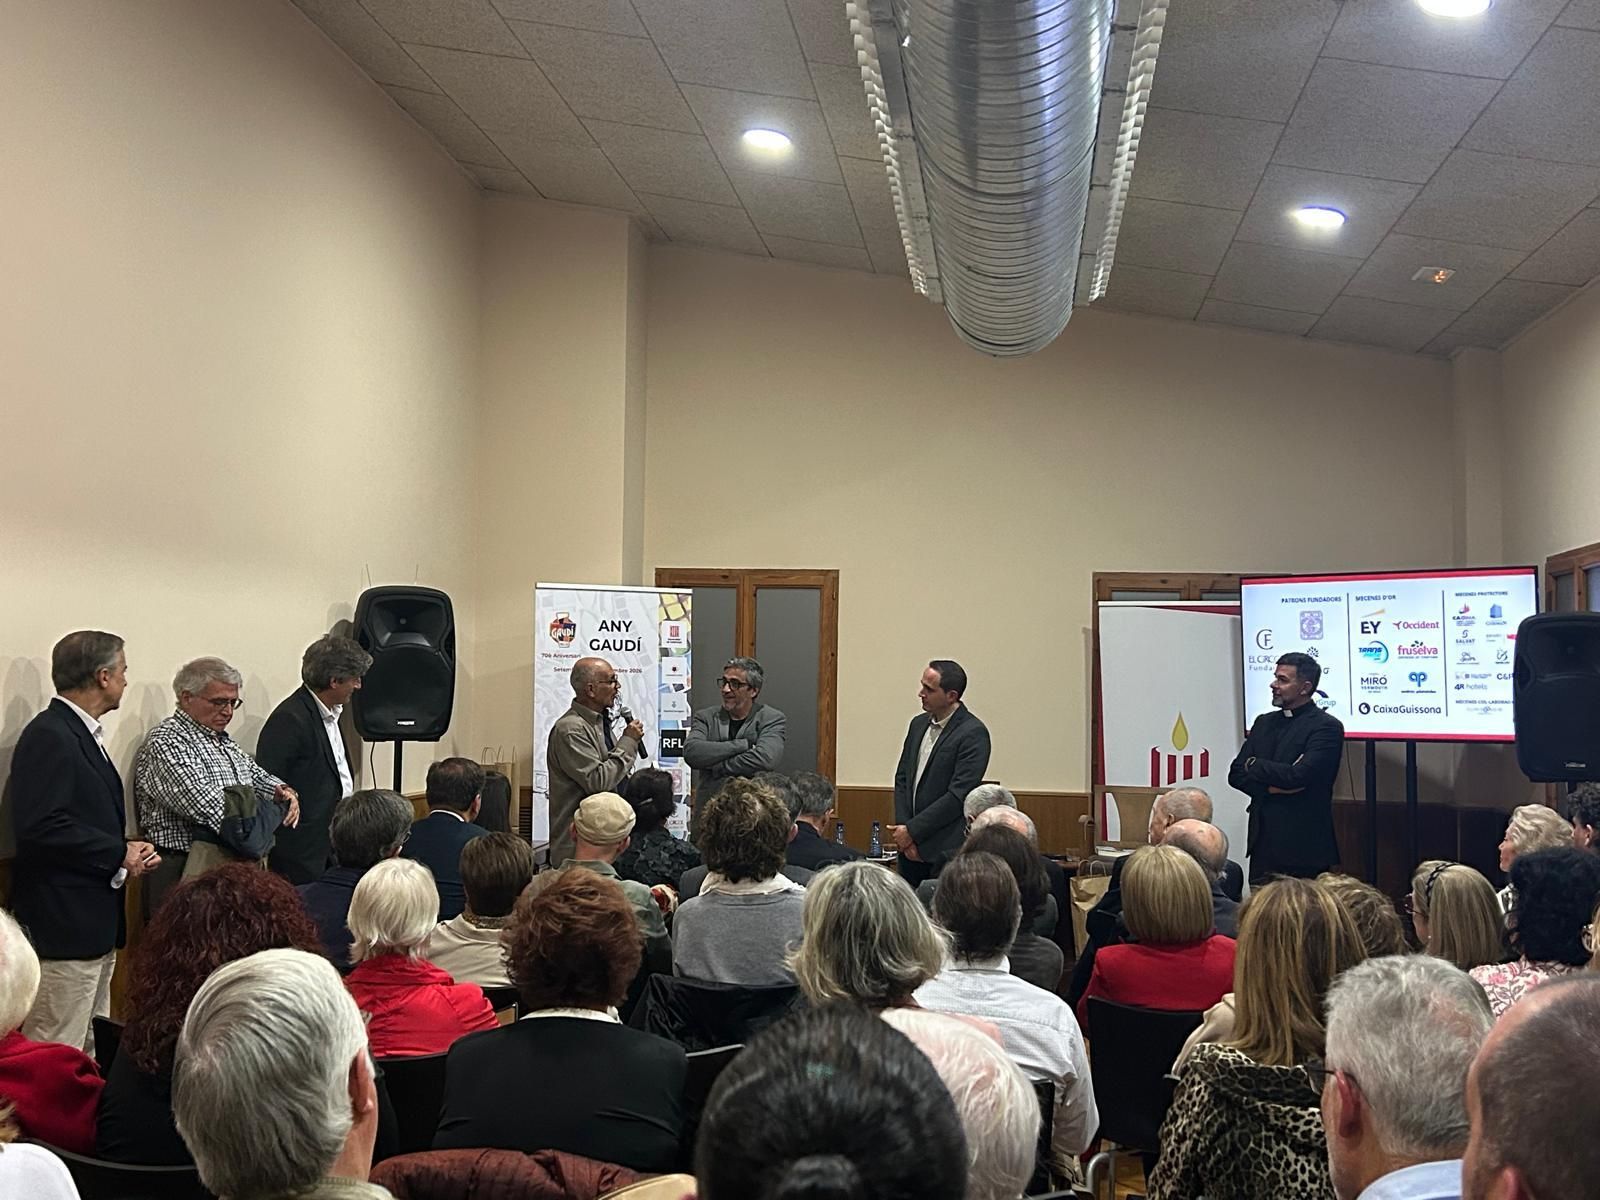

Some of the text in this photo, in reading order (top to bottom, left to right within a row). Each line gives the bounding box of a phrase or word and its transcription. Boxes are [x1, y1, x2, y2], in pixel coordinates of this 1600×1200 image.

[598, 620, 632, 632] ANY
[1360, 620, 1382, 634] EY
[1402, 620, 1440, 630] Occident
[551, 625, 574, 638] GAUDÍ
[589, 636, 642, 652] GAUDÍ
[1397, 644, 1439, 656] fruselva
[1360, 674, 1388, 686] MIRÓ
[1373, 704, 1442, 714] CaixaGuissona
[662, 738, 684, 748] RFL
